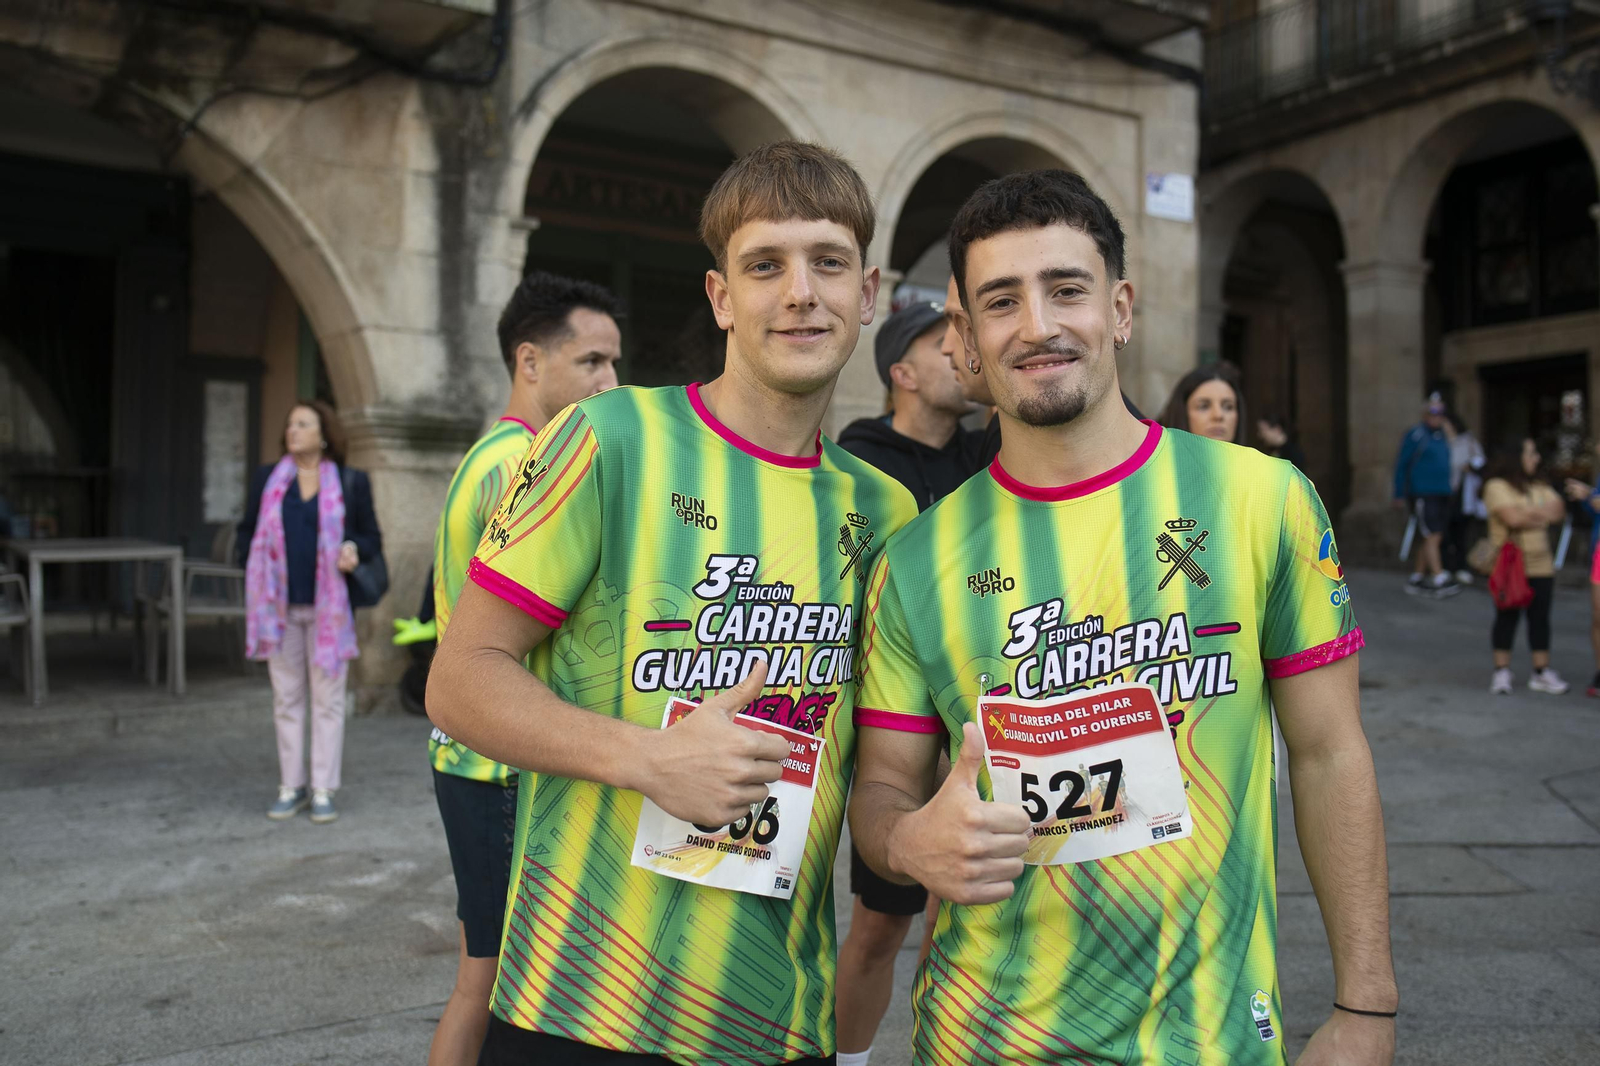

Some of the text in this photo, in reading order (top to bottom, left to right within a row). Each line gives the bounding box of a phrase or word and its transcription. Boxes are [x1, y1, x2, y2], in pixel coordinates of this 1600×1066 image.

[671, 492, 705, 514] RUN
[693, 555, 758, 599] 3ª
[737, 583, 793, 601] EDICIÓN
[967, 567, 1001, 589] RUN
[696, 604, 852, 643] CARRERA
[1002, 598, 1063, 657] 3ª
[1048, 616, 1102, 646] EDICIÓN
[1016, 614, 1190, 698] CARRERA
[1009, 697, 1132, 727] III CARRERA DEL PILAR
[1003, 728, 1035, 744] GUARDIA
[1036, 729, 1068, 744] CIVIL
[1070, 724, 1088, 738] DE
[1090, 711, 1153, 732] OURENSE
[1021, 758, 1123, 823] 527
[1033, 814, 1124, 837] MARCOS FERNANDEZ
[686, 834, 771, 861] DAVID FERREIRO RODICIO
